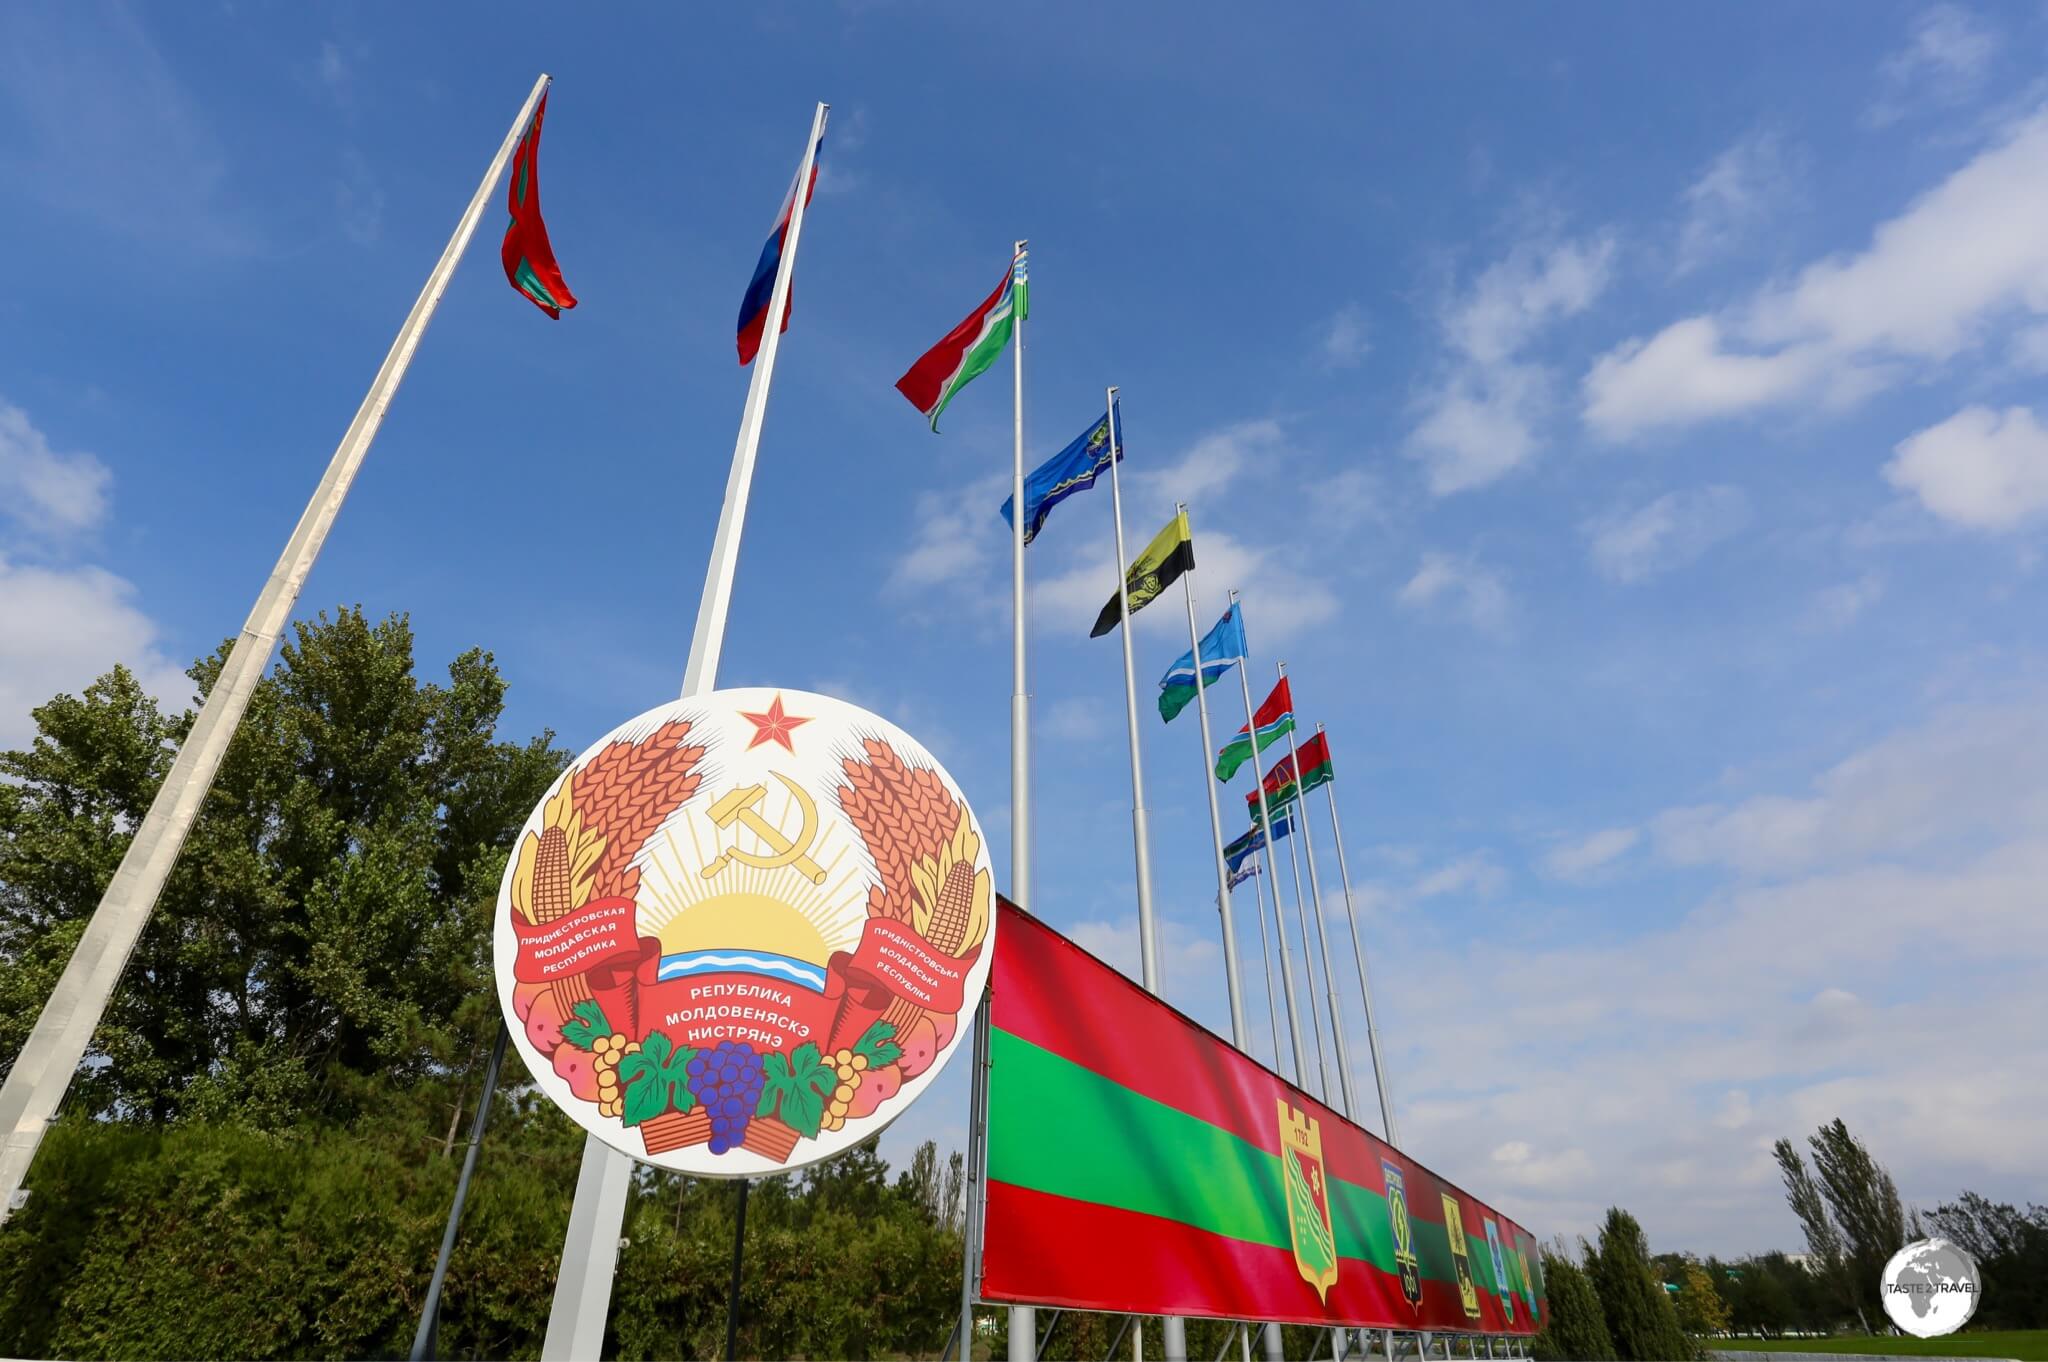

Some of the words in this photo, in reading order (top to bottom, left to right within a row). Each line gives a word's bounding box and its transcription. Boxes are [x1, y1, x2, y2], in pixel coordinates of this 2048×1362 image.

[521, 907, 625, 945] ПРИДНЕСТРОВСКАЯ
[534, 923, 616, 959] МОЛДАВСКАЯ
[543, 939, 617, 974] РЕСПУБЛИКА
[874, 927, 959, 979] ПРИДНІСТРОВСЬКА
[879, 946, 938, 988] МОЛДАВСЬКА
[690, 984, 792, 1007] РЕПУБЛИКА
[876, 961, 931, 1002] РЕСПУБЛІКА
[665, 1005, 810, 1037] МОЛДОВЕНЯСКЭ
[688, 1025, 783, 1047] НИСТРЯНЭ
